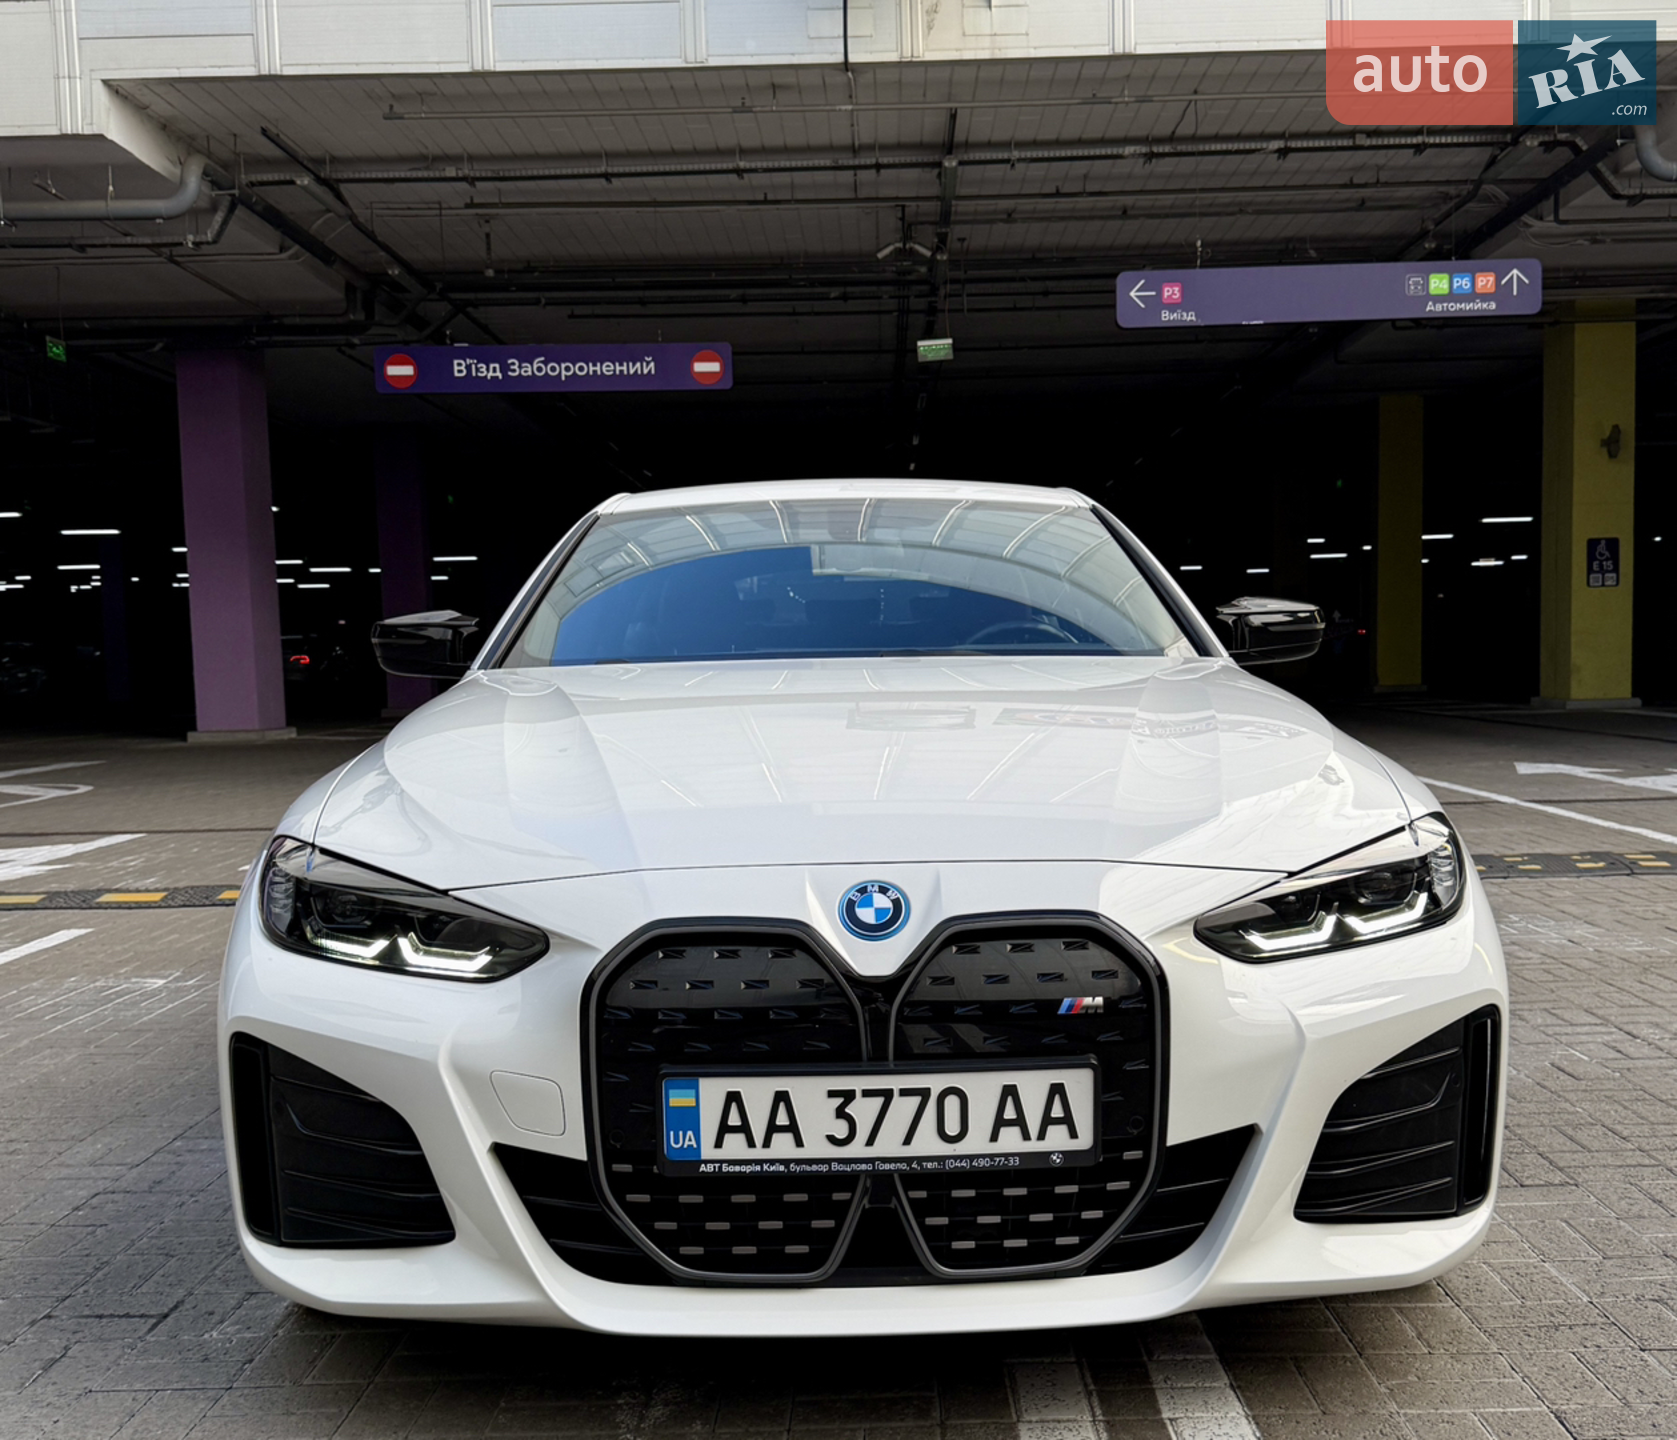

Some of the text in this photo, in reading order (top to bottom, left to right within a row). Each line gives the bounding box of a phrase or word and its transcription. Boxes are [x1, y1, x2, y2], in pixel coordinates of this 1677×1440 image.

[1164, 276, 1494, 299] P3 P4 P6 P7
[1425, 299, 1497, 312] Автомийка
[1161, 309, 1196, 322] Виїзд
[452, 357, 656, 380] В'їзд Заборонений
[850, 884, 899, 901] BMW
[713, 1082, 1079, 1149] AA 3770 AA
[669, 1130, 698, 1149] UA
[945, 1158, 970, 1170] (044)
[972, 1156, 1020, 1168] 490-77-33
